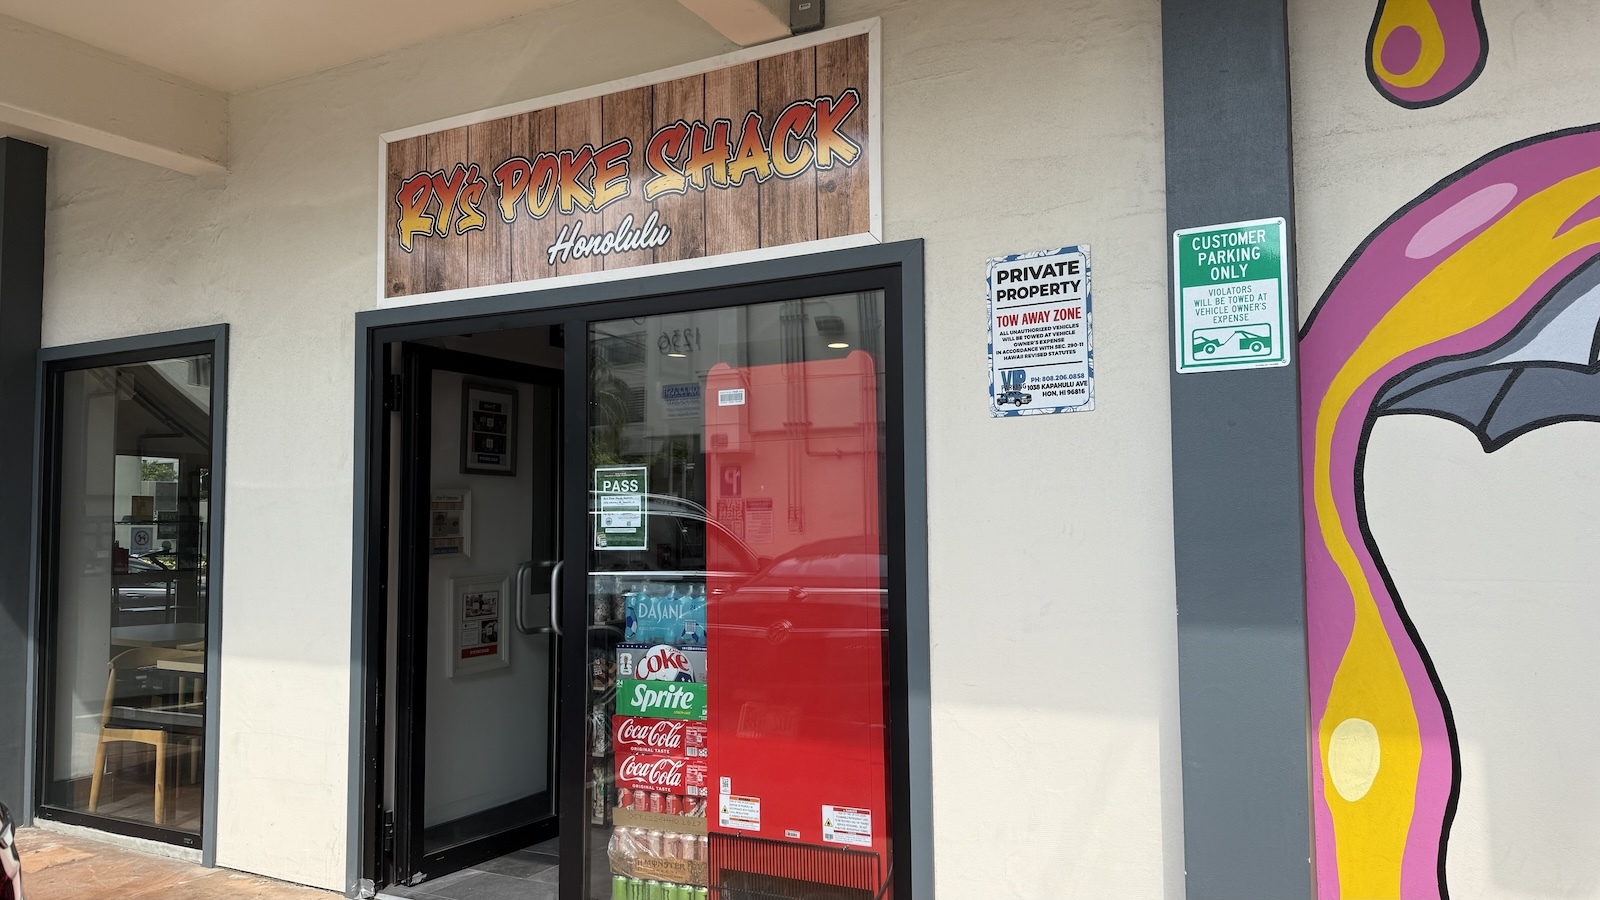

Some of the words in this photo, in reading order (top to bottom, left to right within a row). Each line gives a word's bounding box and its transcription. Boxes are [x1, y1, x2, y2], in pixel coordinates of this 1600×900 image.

[493, 138, 632, 223] POKE
[644, 88, 861, 202] SHACK
[547, 210, 671, 264] Honolulu
[1192, 229, 1266, 251] CUSTOMER
[1198, 246, 1261, 266] PARKING
[997, 260, 1080, 285] PRIVATE
[1210, 263, 1248, 281] ONLY
[996, 279, 1082, 302] PROPERTY
[1194, 299, 1212, 307] WILL
[1215, 297, 1225, 305] BE
[1228, 294, 1255, 304] TOWED
[1257, 292, 1268, 301] AT
[1208, 285, 1252, 297] VIOLATORS
[996, 314, 1019, 328] TOW
[1021, 310, 1050, 326] AWAY
[1053, 306, 1082, 322] ZONE
[1195, 305, 1229, 316] VEHICLE
[1231, 302, 1267, 313] OWNER'S
[1213, 313, 1249, 324] EXPENSE
[1010, 326, 1052, 335] UNAUTHORIZED
[1052, 323, 1079, 331] VEHICLES
[1002, 346, 1039, 355] ACCORDANCE
[1039, 337, 1065, 345] EXPENSE
[1048, 349, 1076, 357] STATUTES
[1001, 369, 1027, 391] VIP
[1041, 381, 1075, 390] KAPAHULU
[603, 479, 639, 492] PASS
[638, 599, 683, 624] DASANI
[630, 684, 695, 712] Sprite
[617, 718, 687, 748] Coca-Cola
[620, 755, 687, 786] Coca-Cola
